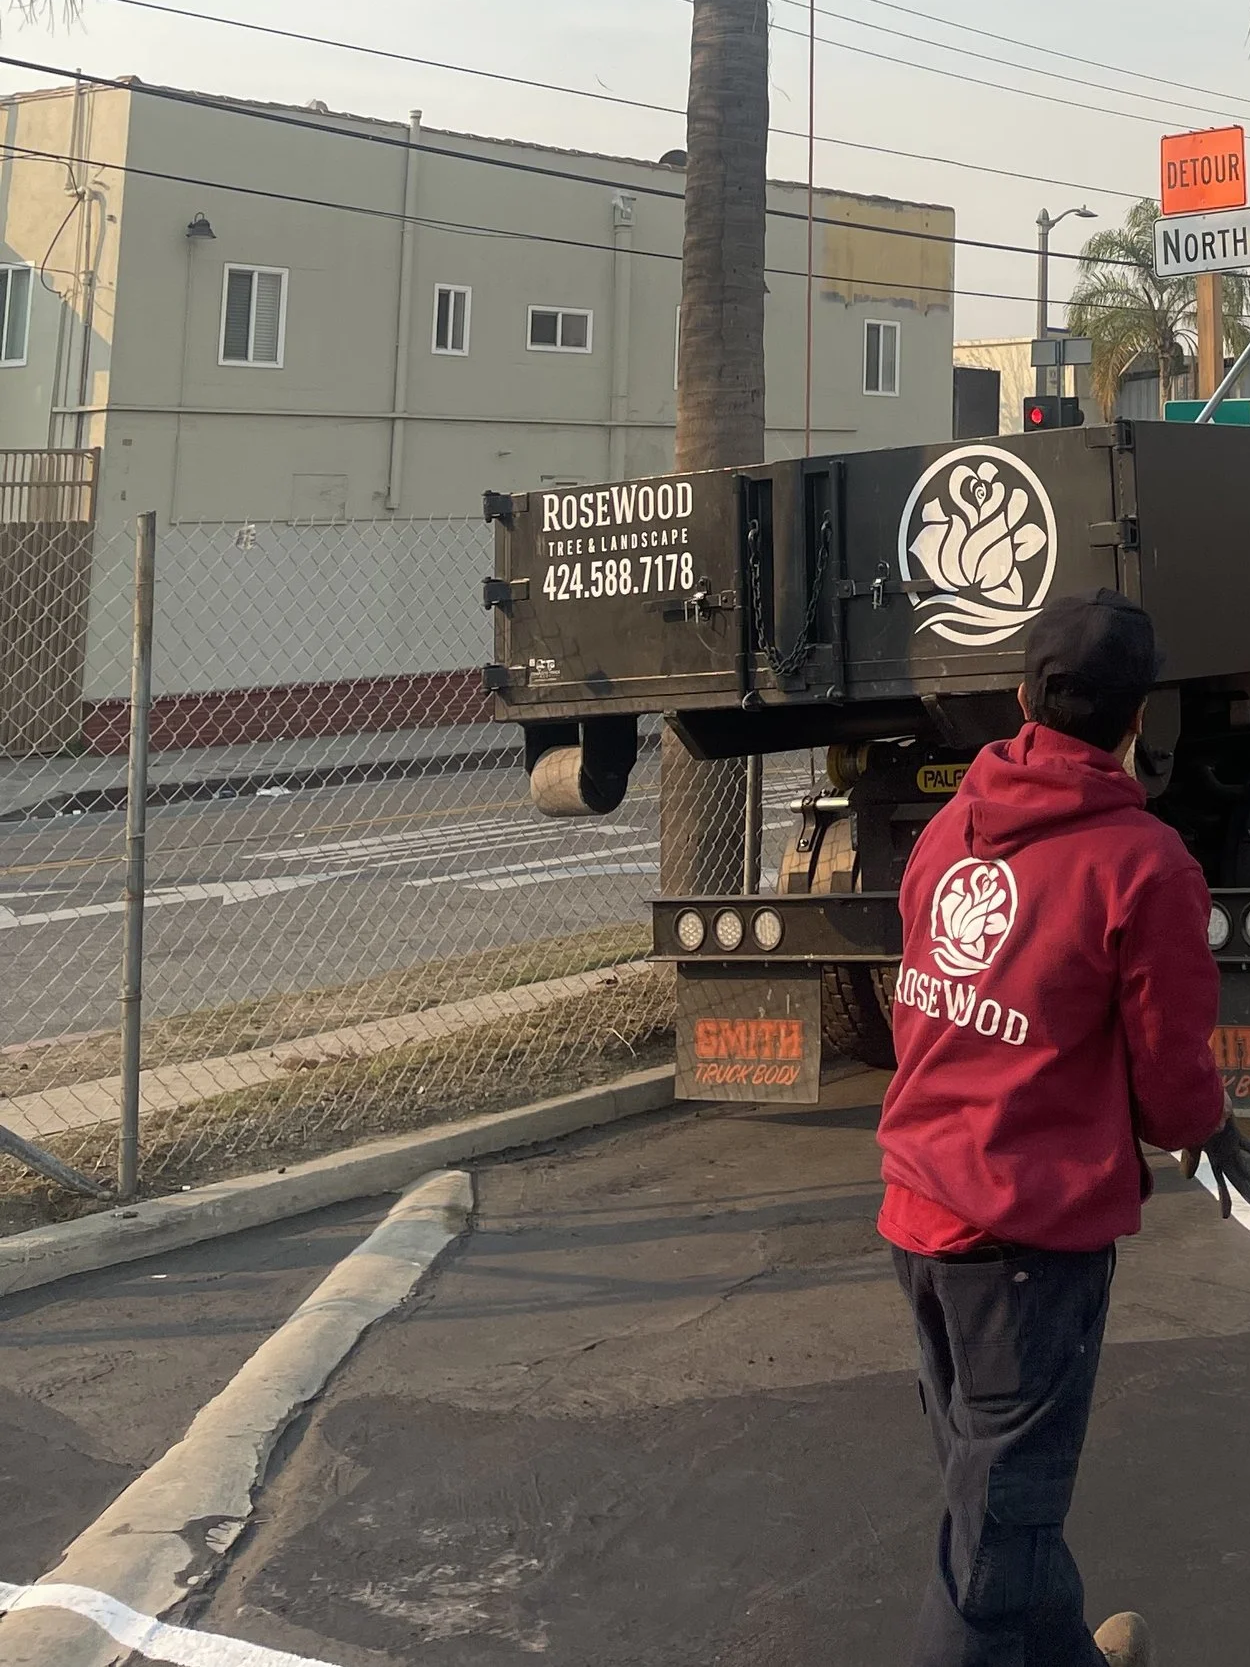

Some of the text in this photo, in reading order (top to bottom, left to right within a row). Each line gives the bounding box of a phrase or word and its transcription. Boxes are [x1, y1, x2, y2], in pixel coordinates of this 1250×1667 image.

[1167, 153, 1240, 189] DETOUR
[1163, 227, 1248, 265] NORTH
[542, 482, 693, 532] ROSEWOOD
[548, 528, 688, 557] TREE & LANDSCAPE
[543, 552, 694, 601] 424.588.7178
[924, 768, 969, 788] PALF
[695, 1018, 803, 1060] SMITH
[695, 1063, 800, 1086] TRUCK BODY
